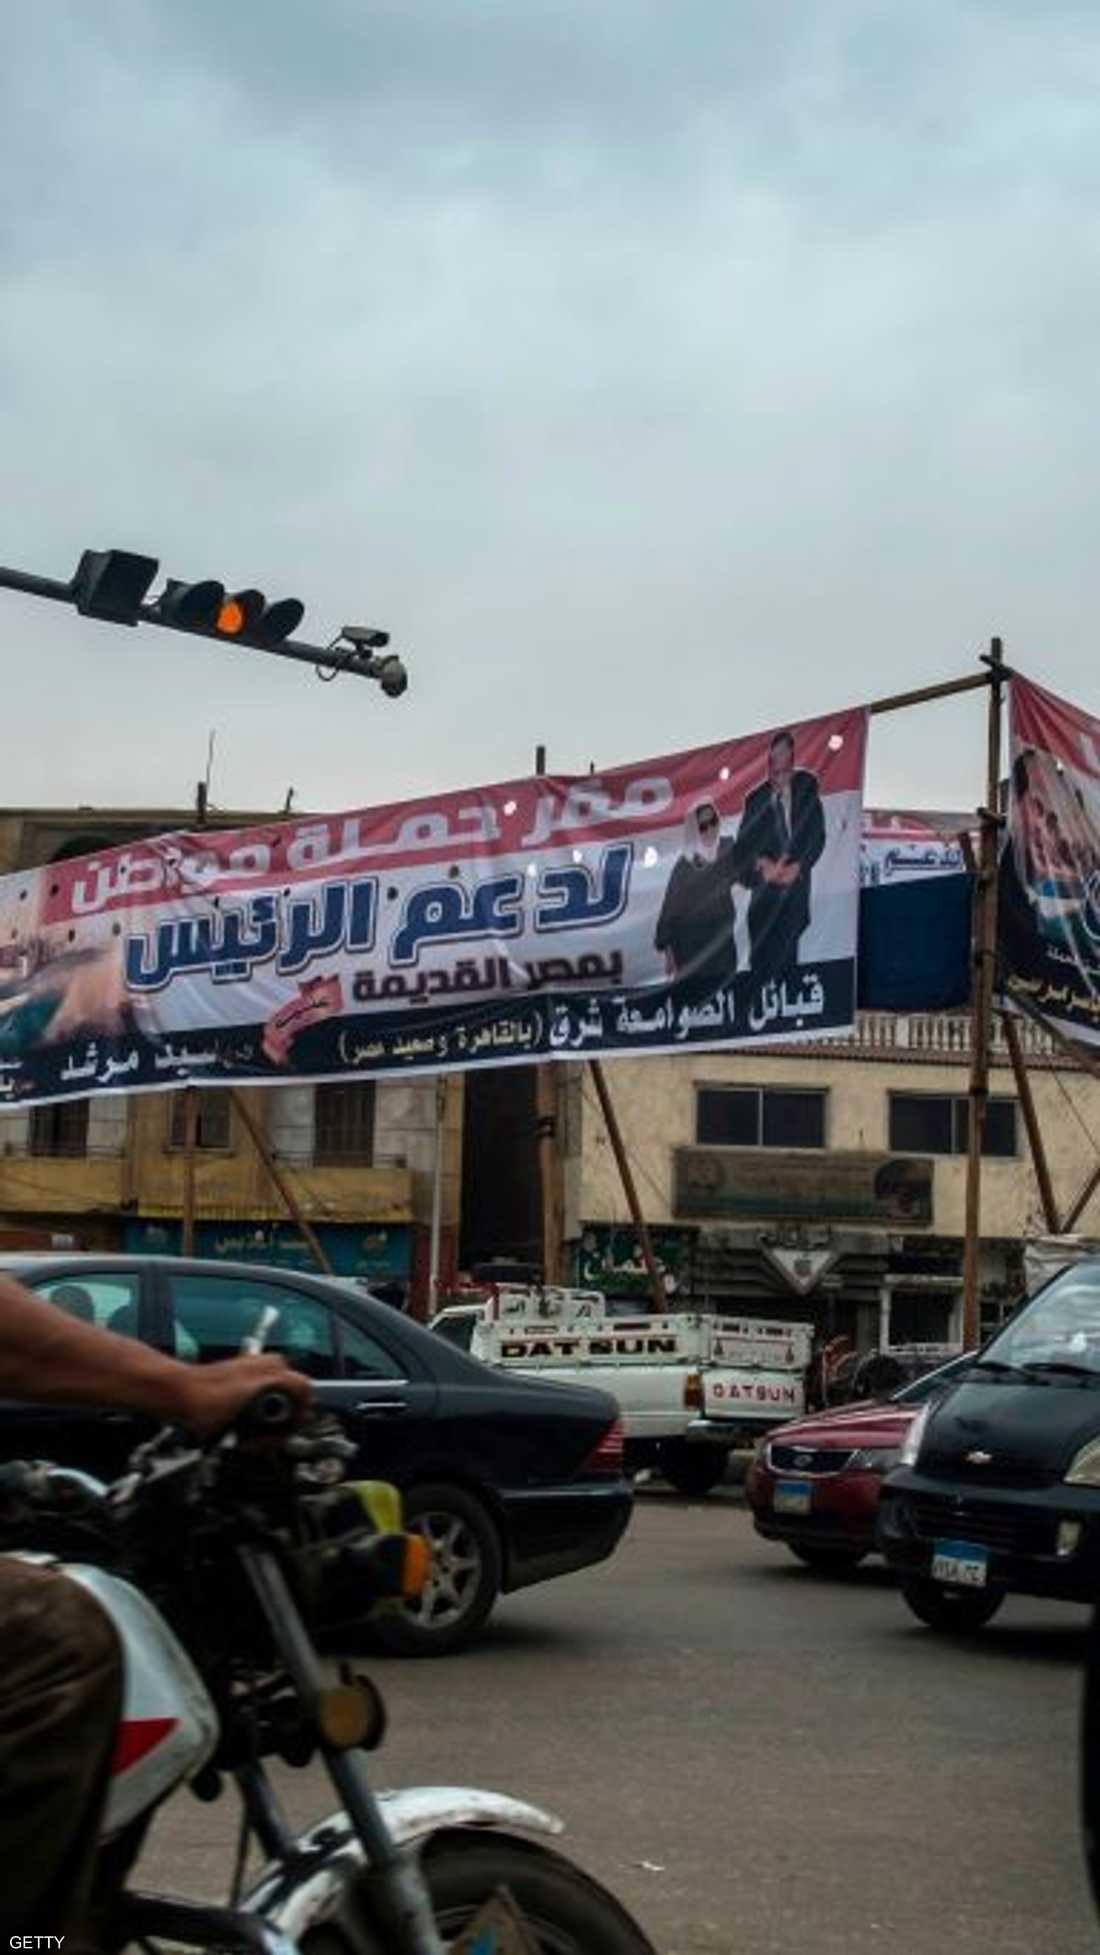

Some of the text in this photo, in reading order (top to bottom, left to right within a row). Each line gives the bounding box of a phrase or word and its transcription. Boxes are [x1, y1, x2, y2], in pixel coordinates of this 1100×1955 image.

[287, 804, 499, 868] حملة
[521, 777, 675, 849] مقر
[124, 842, 633, 992] لدعم الرئيس
[352, 949, 624, 1004] بمصر القديمة
[748, 973, 825, 1031] قبائل
[550, 997, 604, 1047] شرق
[613, 988, 735, 1039] الصوامعة
[501, 1339, 677, 1358] DATSUN
[712, 1383, 795, 1403] DATSUN
